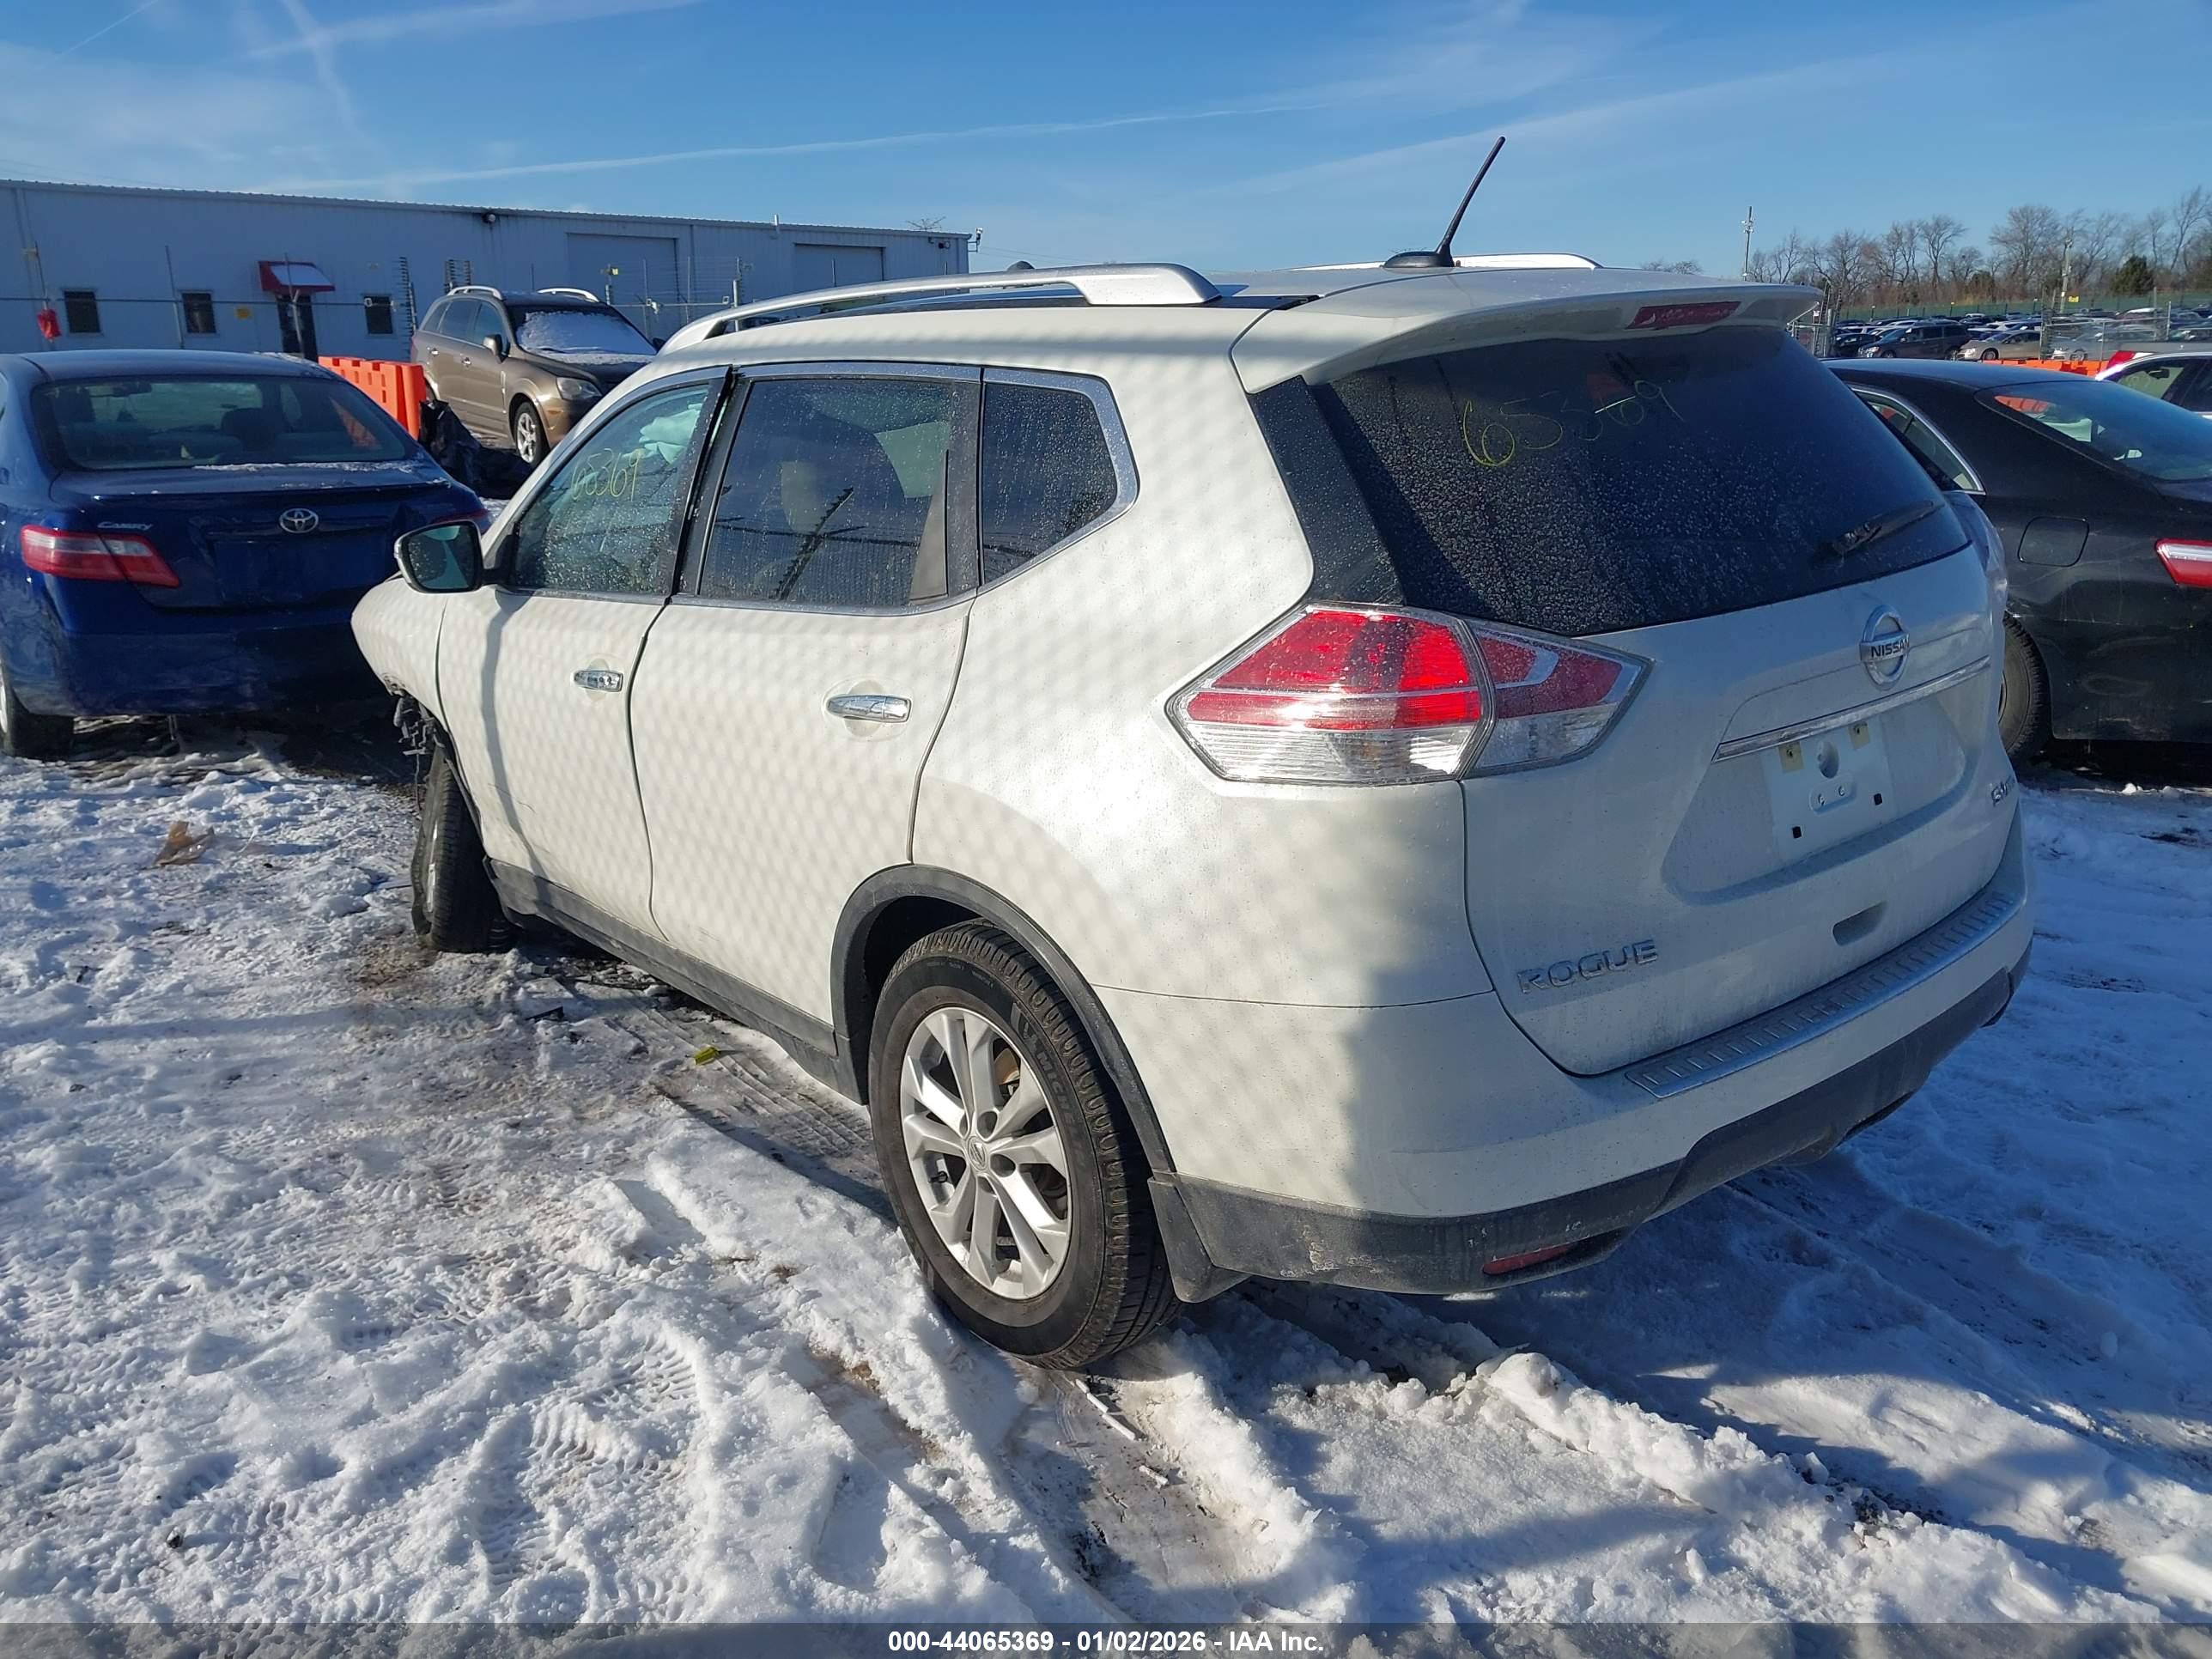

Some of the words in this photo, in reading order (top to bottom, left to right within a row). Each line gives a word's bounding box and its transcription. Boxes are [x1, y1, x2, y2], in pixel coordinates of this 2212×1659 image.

[571, 447, 646, 501] 65369
[1870, 634, 1910, 659] NISSAN
[1517, 939, 1659, 994] ROGUE
